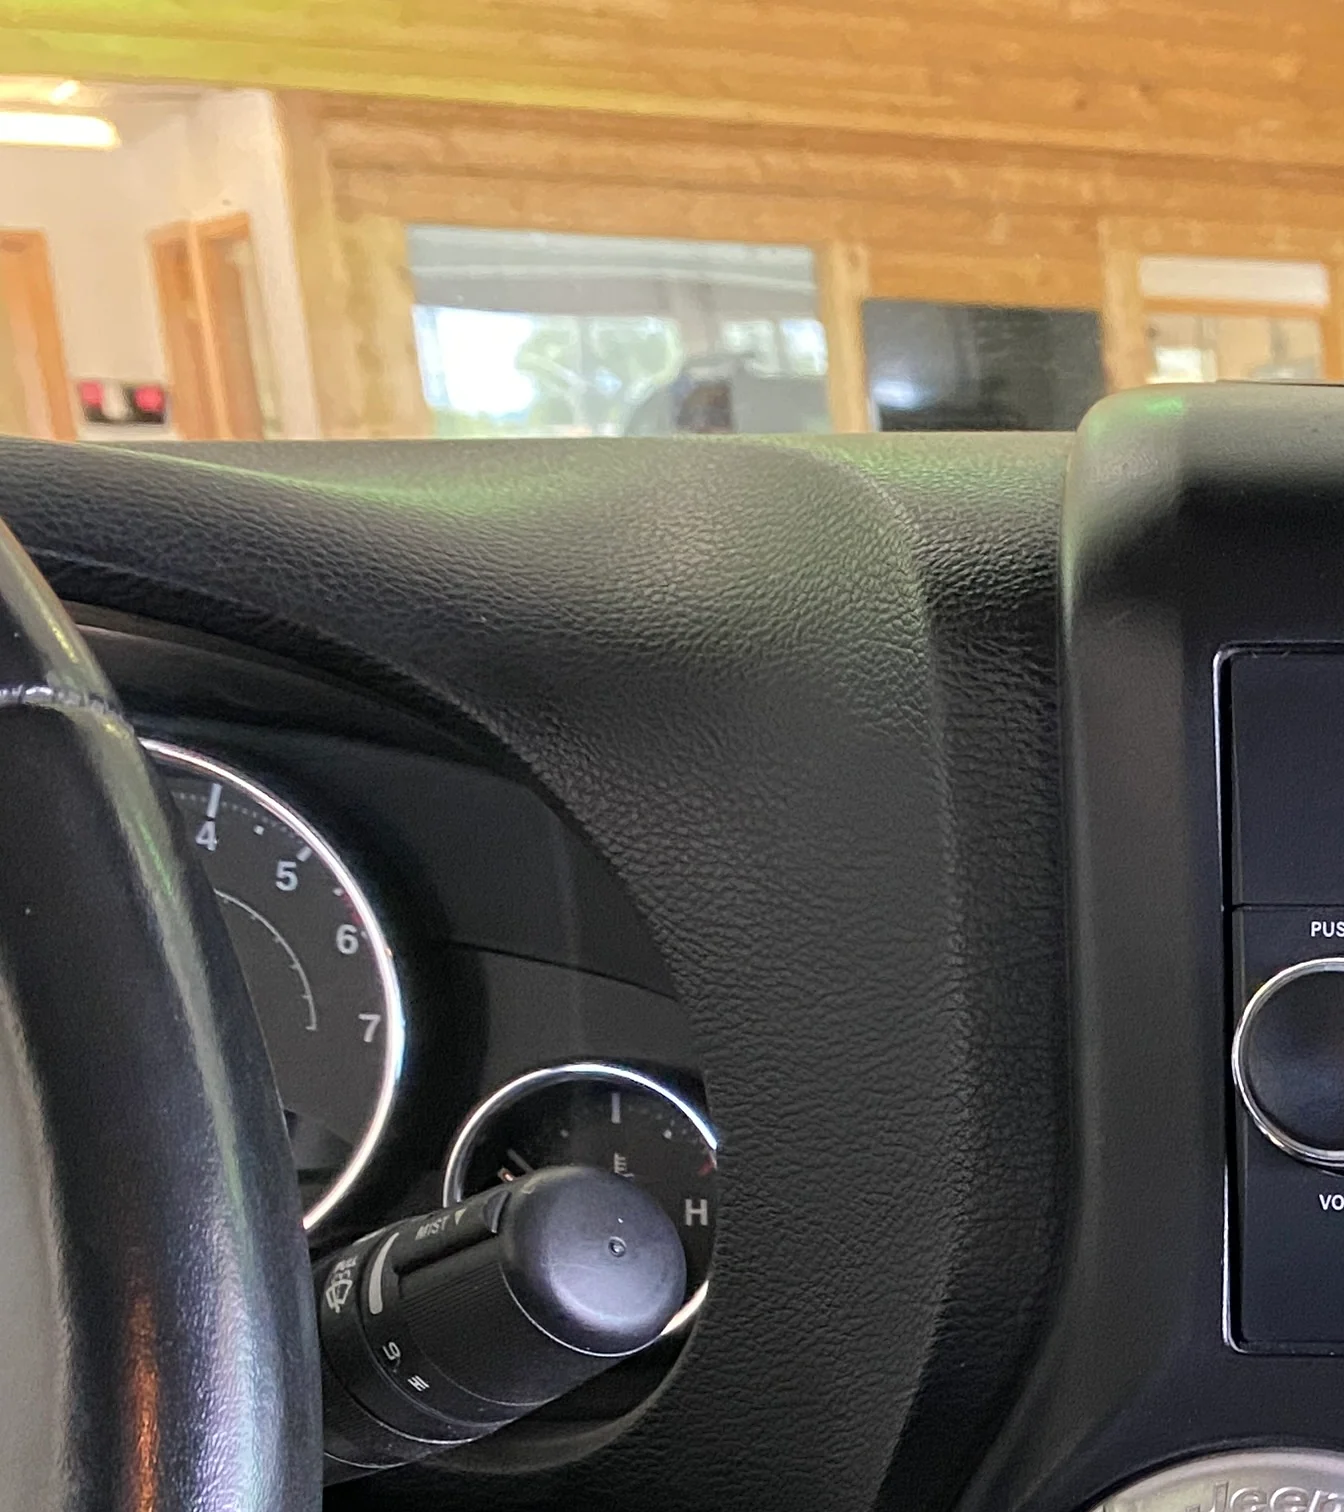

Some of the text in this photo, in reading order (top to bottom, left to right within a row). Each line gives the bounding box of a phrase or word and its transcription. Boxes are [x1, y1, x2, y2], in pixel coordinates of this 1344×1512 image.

[195, 825, 218, 852] 4
[275, 860, 299, 892] 5
[335, 923, 360, 955] 6
[357, 1013, 382, 1043] 7
[685, 1198, 709, 1227] H
